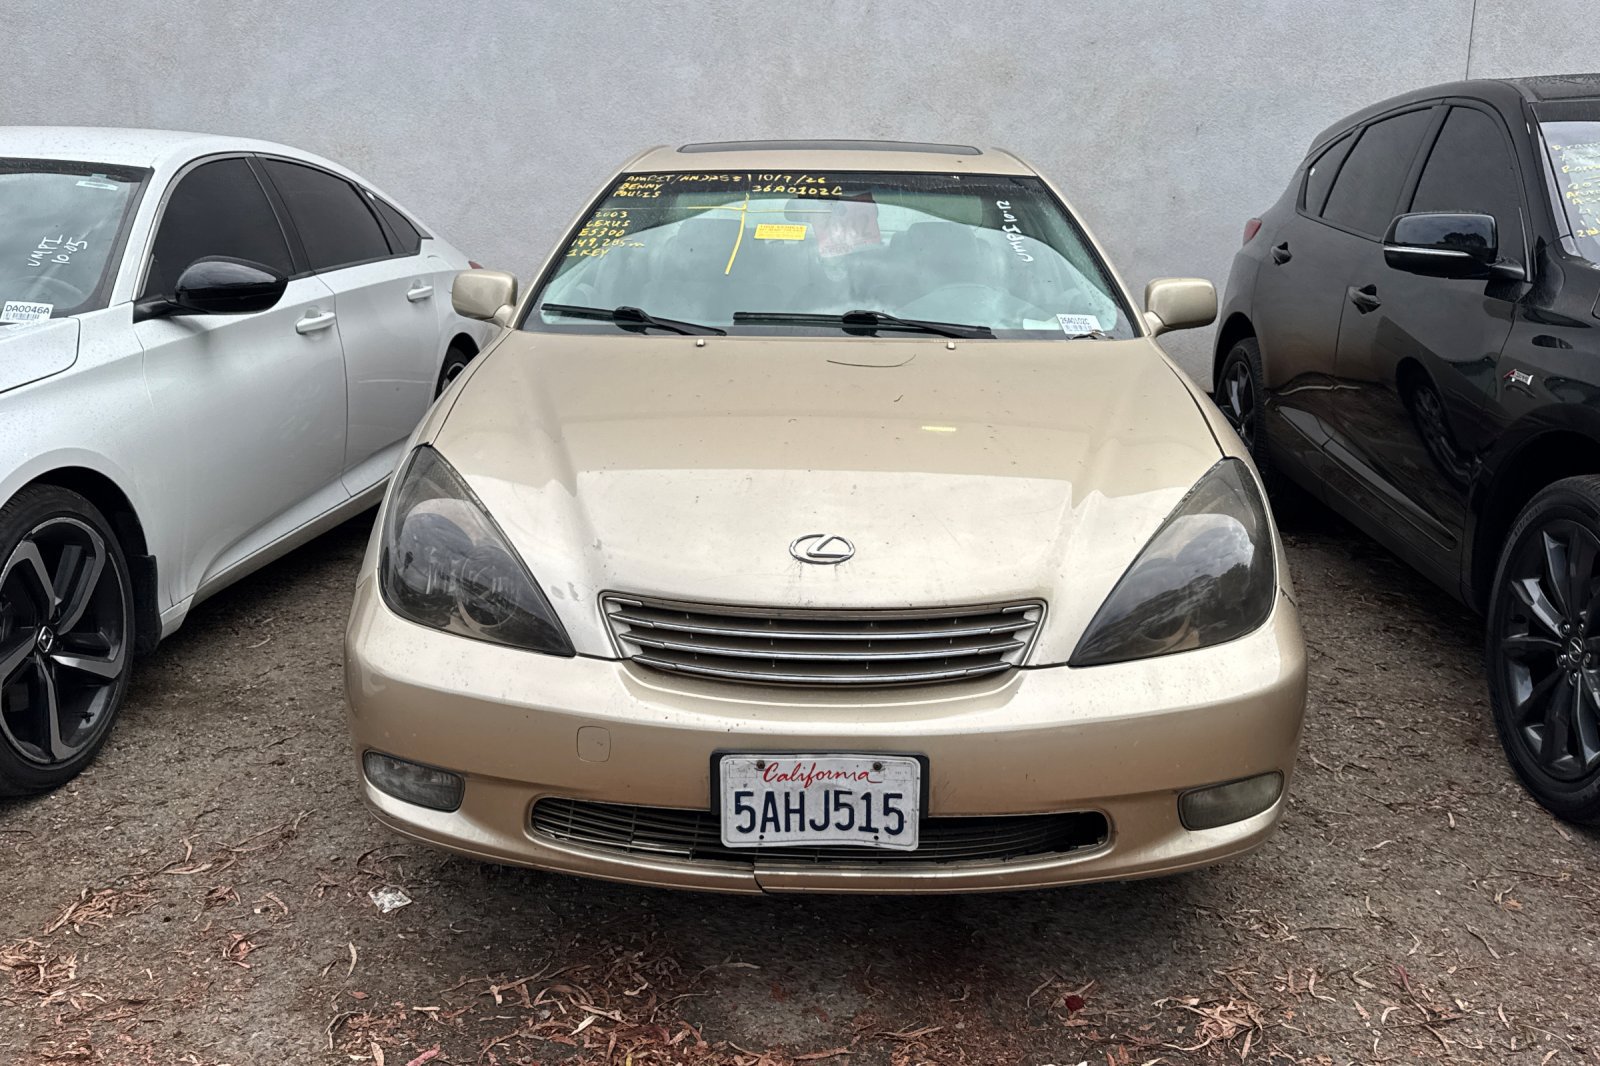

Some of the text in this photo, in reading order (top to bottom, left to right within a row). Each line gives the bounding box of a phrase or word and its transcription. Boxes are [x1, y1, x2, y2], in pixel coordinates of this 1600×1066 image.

[596, 211, 628, 219] 2003
[5, 304, 50, 314] DA0046A
[763, 762, 882, 788] California
[734, 789, 905, 836] 5AHJ515
